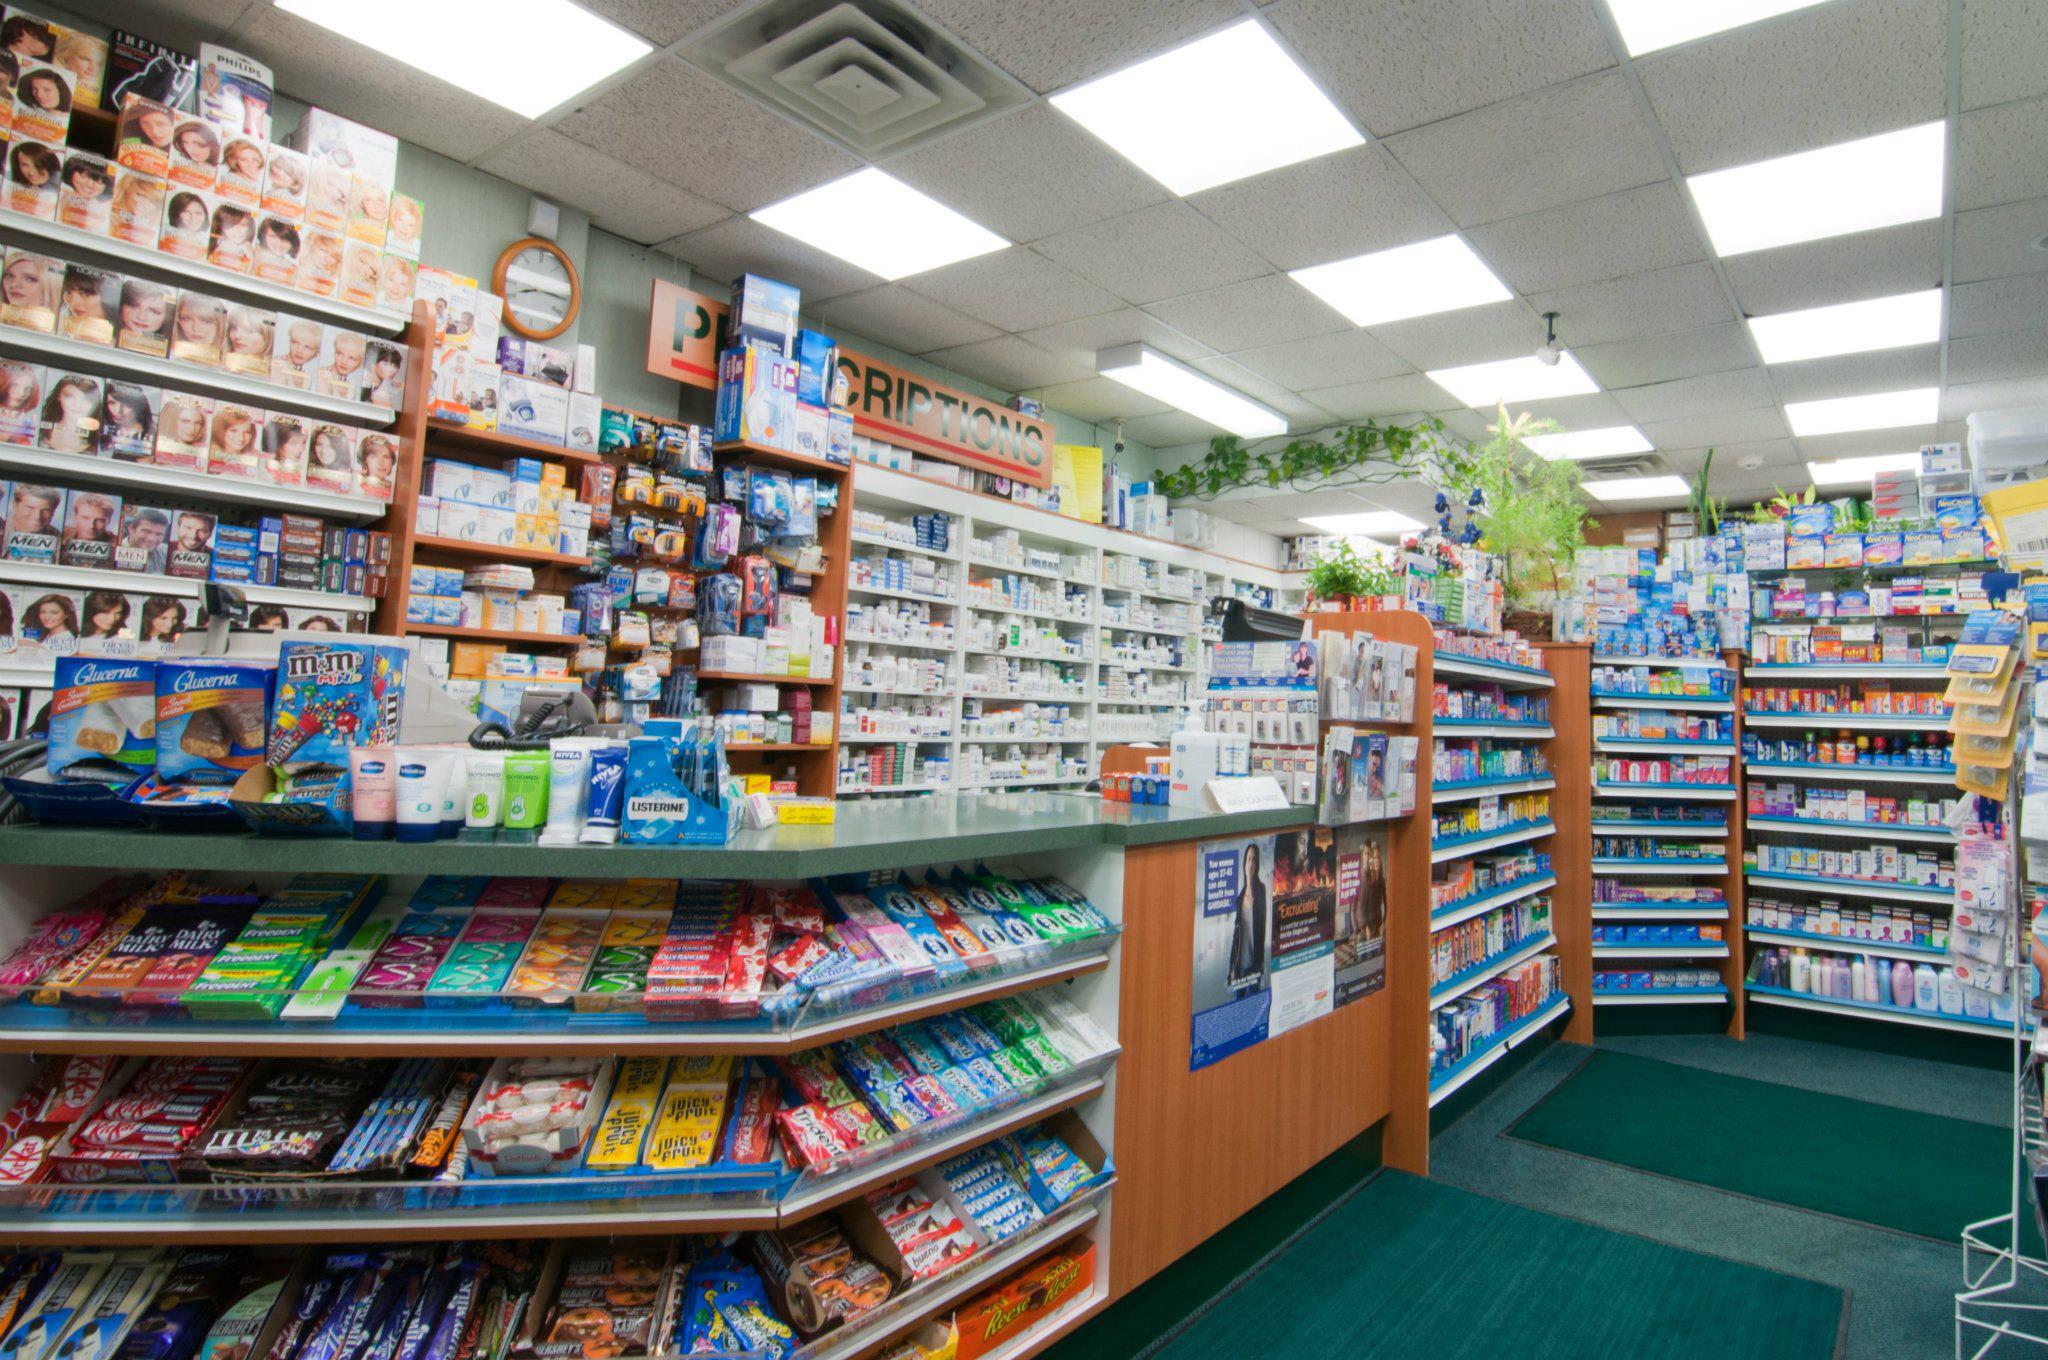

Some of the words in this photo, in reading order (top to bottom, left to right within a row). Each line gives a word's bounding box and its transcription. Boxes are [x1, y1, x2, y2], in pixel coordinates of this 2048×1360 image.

[217, 54, 262, 79] PHILIPS
[658, 523, 684, 532] DURACELL
[10, 536, 53, 548] MEN
[69, 541, 109, 554] MEN
[117, 551, 145, 561] MEN
[173, 554, 207, 563] MEN
[1844, 648, 1865, 656] Advil
[74, 663, 139, 686] Glucerna
[174, 670, 239, 693] Glucerna
[631, 801, 685, 813] LISTERINE
[125, 934, 172, 945] DAIRY
[176, 929, 225, 940] DAIRY
[114, 943, 163, 953] MILK
[169, 939, 218, 949] MILK
[667, 1097, 710, 1118] juicy
[675, 1106, 717, 1122] fruit
[616, 1109, 641, 1146] juicy
[795, 1109, 844, 1156] Trident
[603, 1116, 623, 1156] fruit
[653, 1136, 698, 1158] juicy
[661, 1147, 706, 1163] fruit
[911, 1242, 940, 1268] bueno
[1043, 1263, 1081, 1306] Reese
[983, 1295, 1032, 1342] Reese
